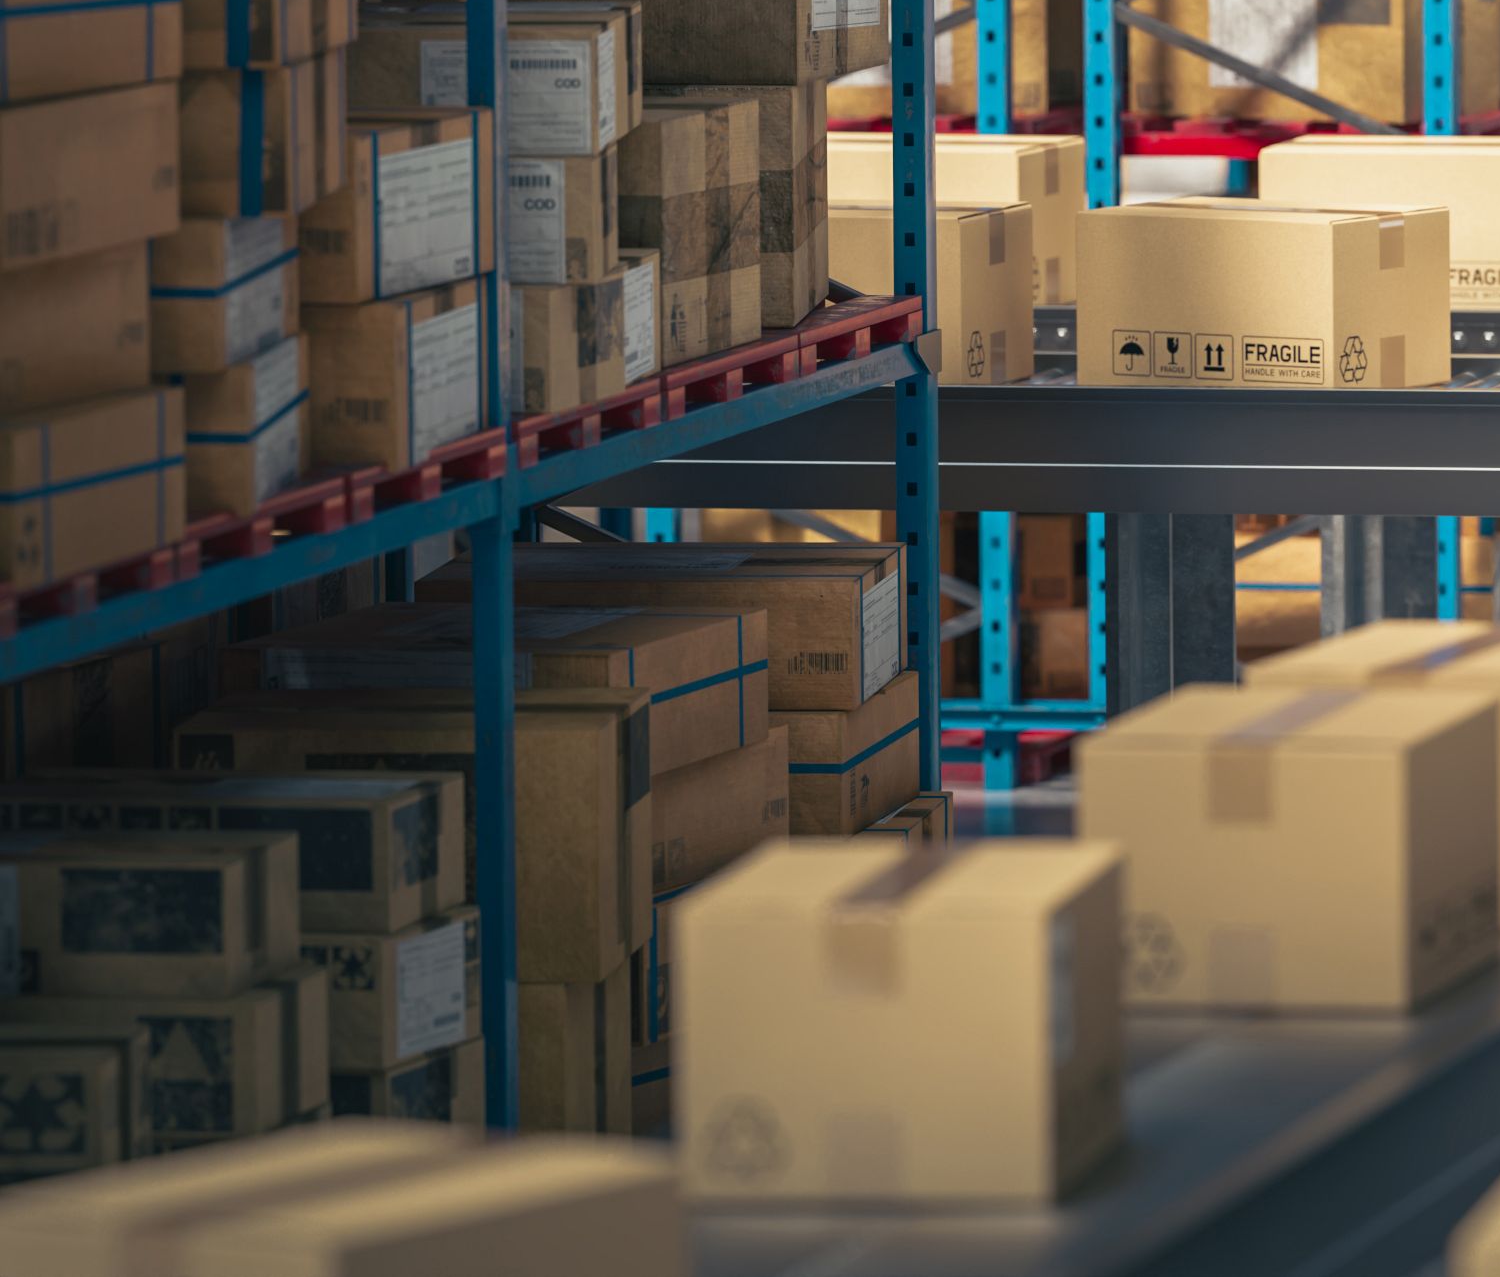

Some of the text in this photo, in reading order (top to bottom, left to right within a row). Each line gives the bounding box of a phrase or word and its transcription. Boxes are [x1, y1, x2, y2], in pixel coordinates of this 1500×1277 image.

[524, 198, 556, 211] COD
[1245, 343, 1320, 364] FRAGILE
[1245, 368, 1320, 379] HANDLE WITH CARE
